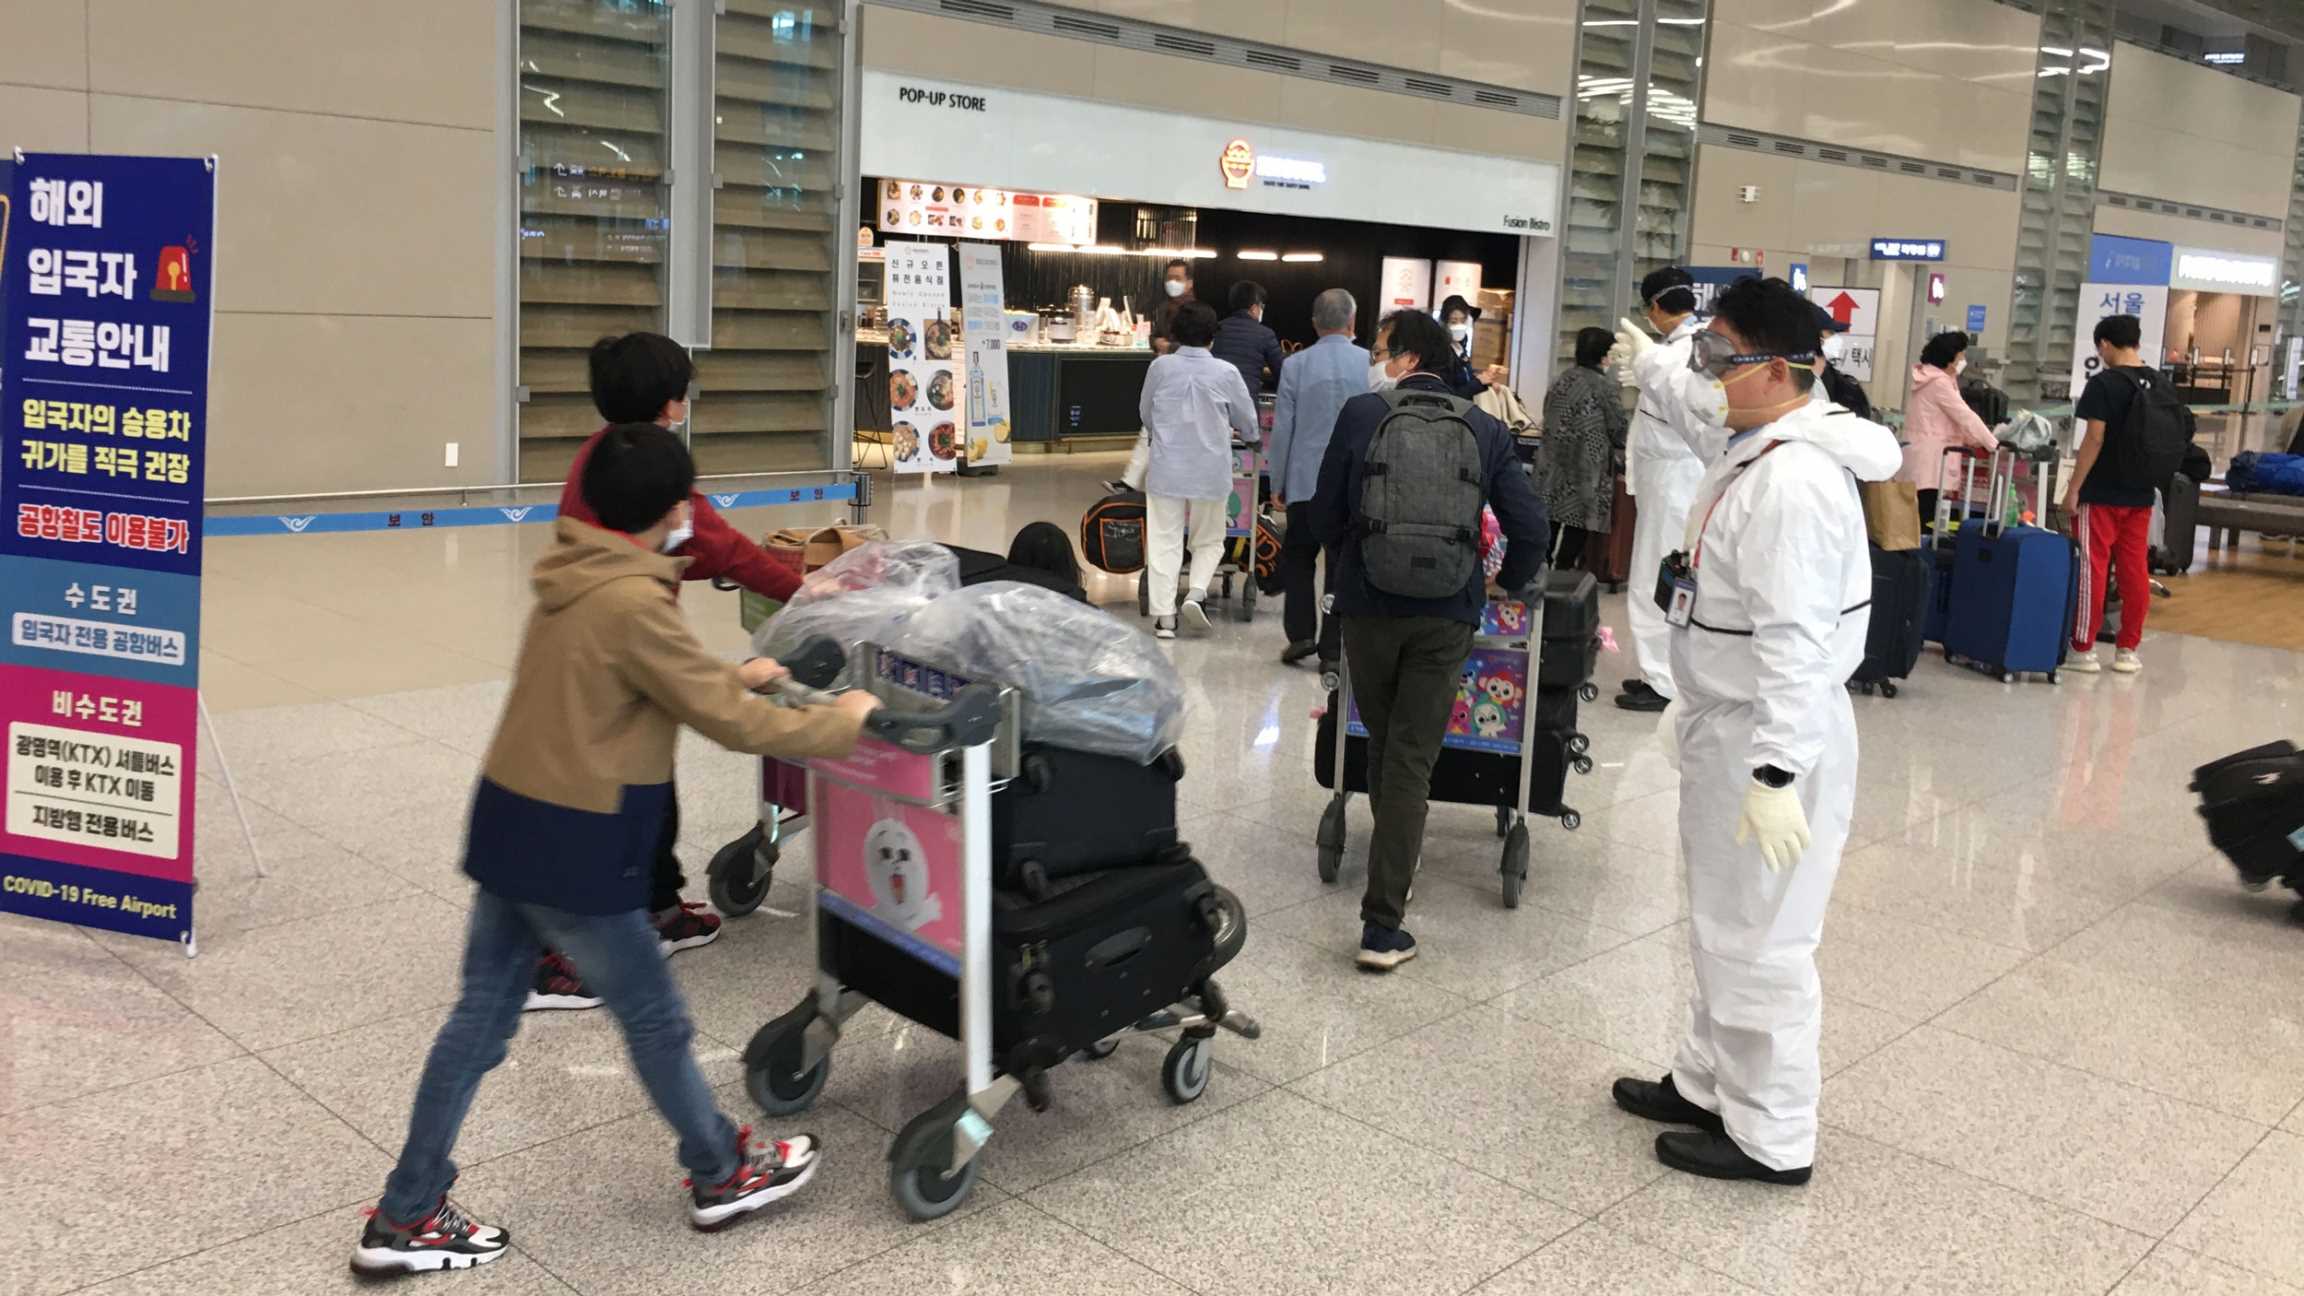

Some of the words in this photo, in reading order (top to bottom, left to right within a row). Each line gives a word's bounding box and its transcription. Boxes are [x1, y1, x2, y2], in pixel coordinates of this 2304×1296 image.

[900, 87, 946, 106] POP-UP
[949, 94, 986, 112] STORE
[29, 177, 104, 229] 해외
[28, 248, 138, 300] 입국자
[2099, 292, 2145, 314] 서울
[24, 317, 171, 373] 교통안내
[23, 399, 116, 435] 입국자의
[121, 407, 191, 442] 승용차
[21, 440, 88, 475] 귀가를
[94, 446, 138, 479] 적극
[144, 451, 190, 485] 권장
[18, 504, 103, 543] 공항철도
[105, 512, 190, 554] 이용불가
[64, 582, 138, 615] 수도권
[21, 619, 71, 645] 입국자
[75, 626, 109, 650] 전용
[113, 630, 179, 658] 공항버스
[52, 690, 143, 727] 비수도권
[16, 734, 112, 768] 광명역(KTX)
[115, 749, 175, 777] 셔틀버스
[34, 764, 64, 788] 이용
[67, 769, 82, 791] 후
[85, 773, 121, 796] KTX
[125, 778, 155, 802] 이동
[33, 805, 82, 832] 지방행
[3, 875, 80, 902] COVID-19
[82, 889, 117, 909] Free
[120, 895, 177, 919] Airport
